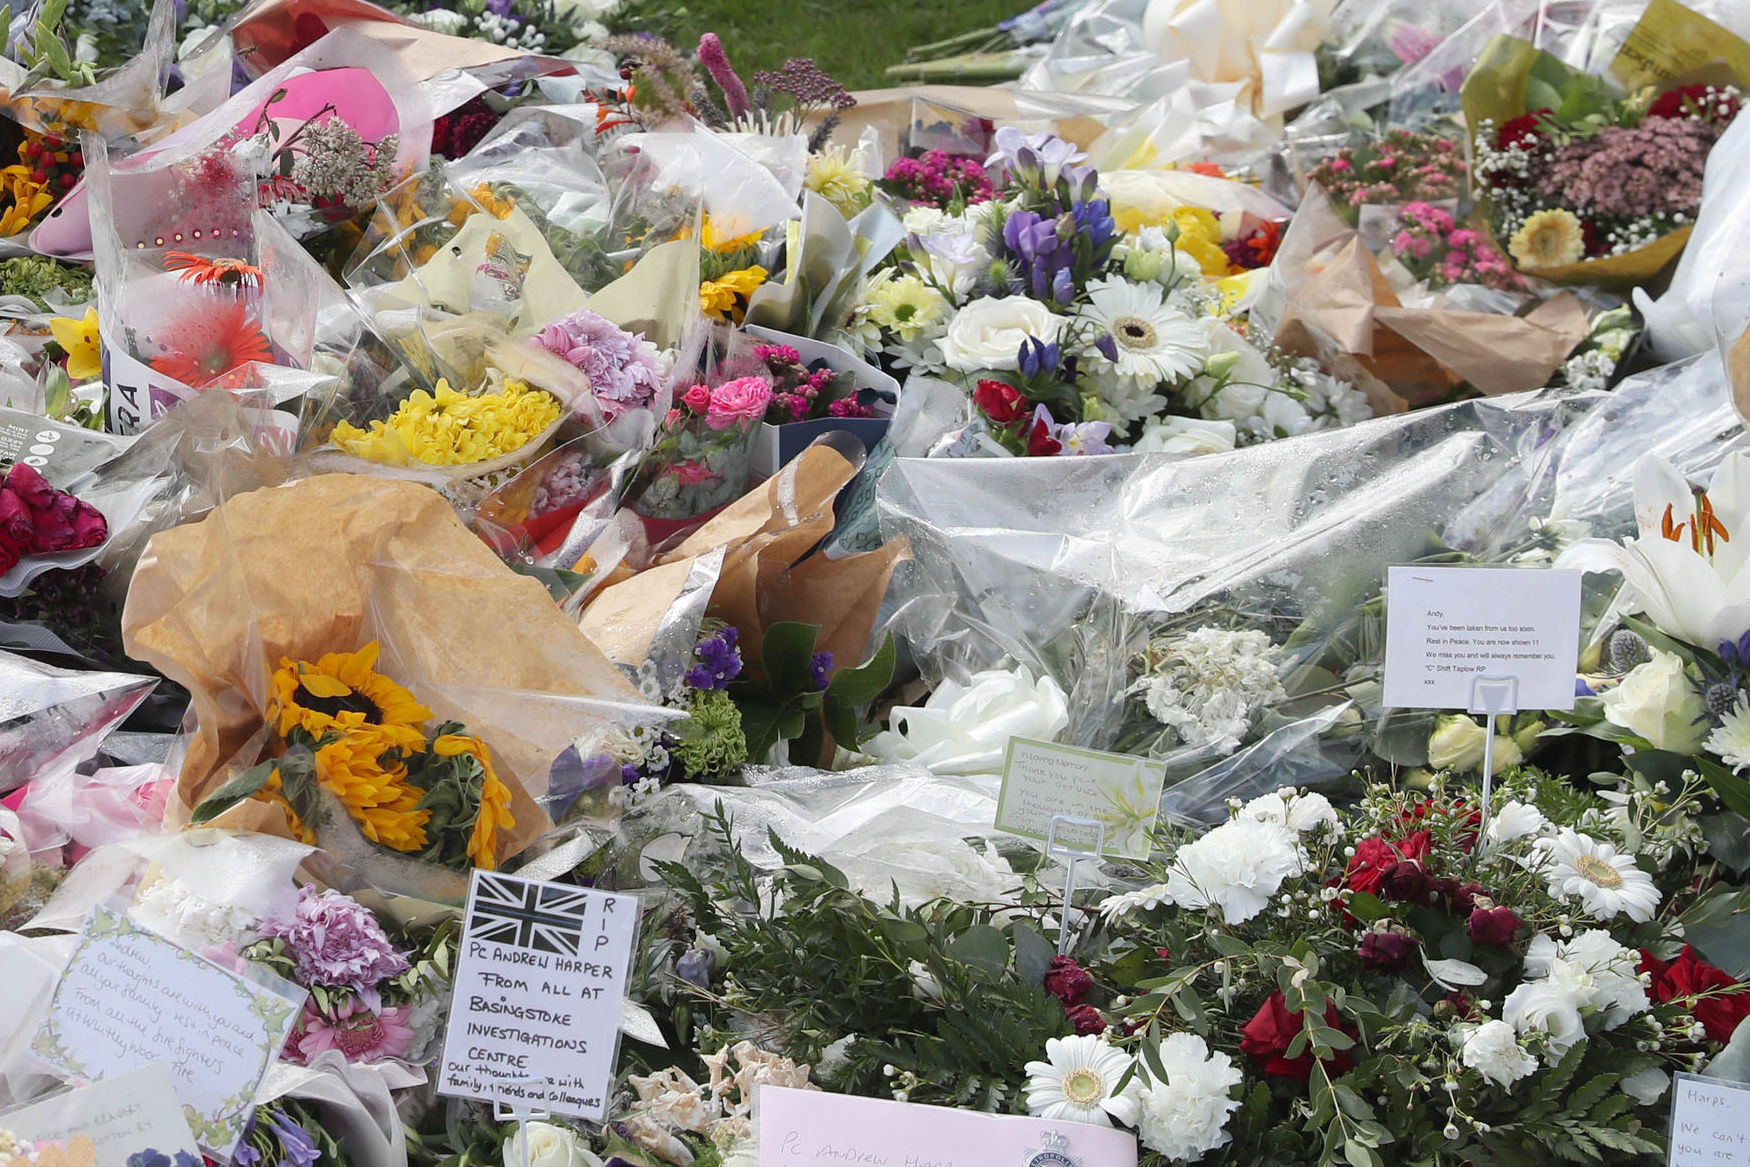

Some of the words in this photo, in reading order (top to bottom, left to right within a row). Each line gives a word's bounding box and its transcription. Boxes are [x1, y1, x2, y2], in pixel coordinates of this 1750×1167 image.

[1427, 624, 1448, 632] You've
[1491, 652, 1511, 661] always
[1452, 665, 1475, 674] Taplow
[1015, 761, 1045, 776] Thank
[1049, 772, 1067, 780] you
[1029, 754, 1054, 765] Loving
[1056, 758, 1089, 771] Memory
[1022, 774, 1046, 784] your
[1023, 800, 1071, 814] thoughts
[1090, 805, 1108, 813] the
[469, 941, 488, 959] PC
[493, 947, 549, 969] ANDREW
[555, 958, 613, 979] HARPER
[478, 972, 528, 991] FROM
[542, 982, 571, 996] ALL
[581, 987, 604, 999] AT
[80, 964, 100, 980] all
[95, 976, 119, 993] your
[121, 983, 163, 1024] family
[174, 1014, 196, 1029] rest
[199, 1025, 209, 1036] in
[211, 1034, 245, 1058] peace
[116, 961, 160, 990] thoughts
[162, 986, 184, 1001] are
[184, 996, 212, 1020] with
[212, 1016, 233, 1030] you
[232, 1023, 255, 1042] and
[75, 986, 101, 1011] From
[106, 1007, 127, 1024] all
[127, 1015, 148, 1037] the
[152, 1027, 176, 1050] fire
[174, 1038, 224, 1075] fighters
[467, 1023, 588, 1053] INVESTIGATIONS
[468, 1047, 528, 1069] CENTRE
[448, 1074, 487, 1093] family,
[528, 1088, 545, 1100] and
[558, 1075, 585, 1089] with
[67, 1122, 89, 1133] AND
[94, 1103, 142, 1126] BRAVERY
[1681, 1122, 1699, 1134] We
[1713, 1131, 1746, 1144] can't
[1677, 1144, 1702, 1155] you
[1714, 1151, 1733, 1160] are
